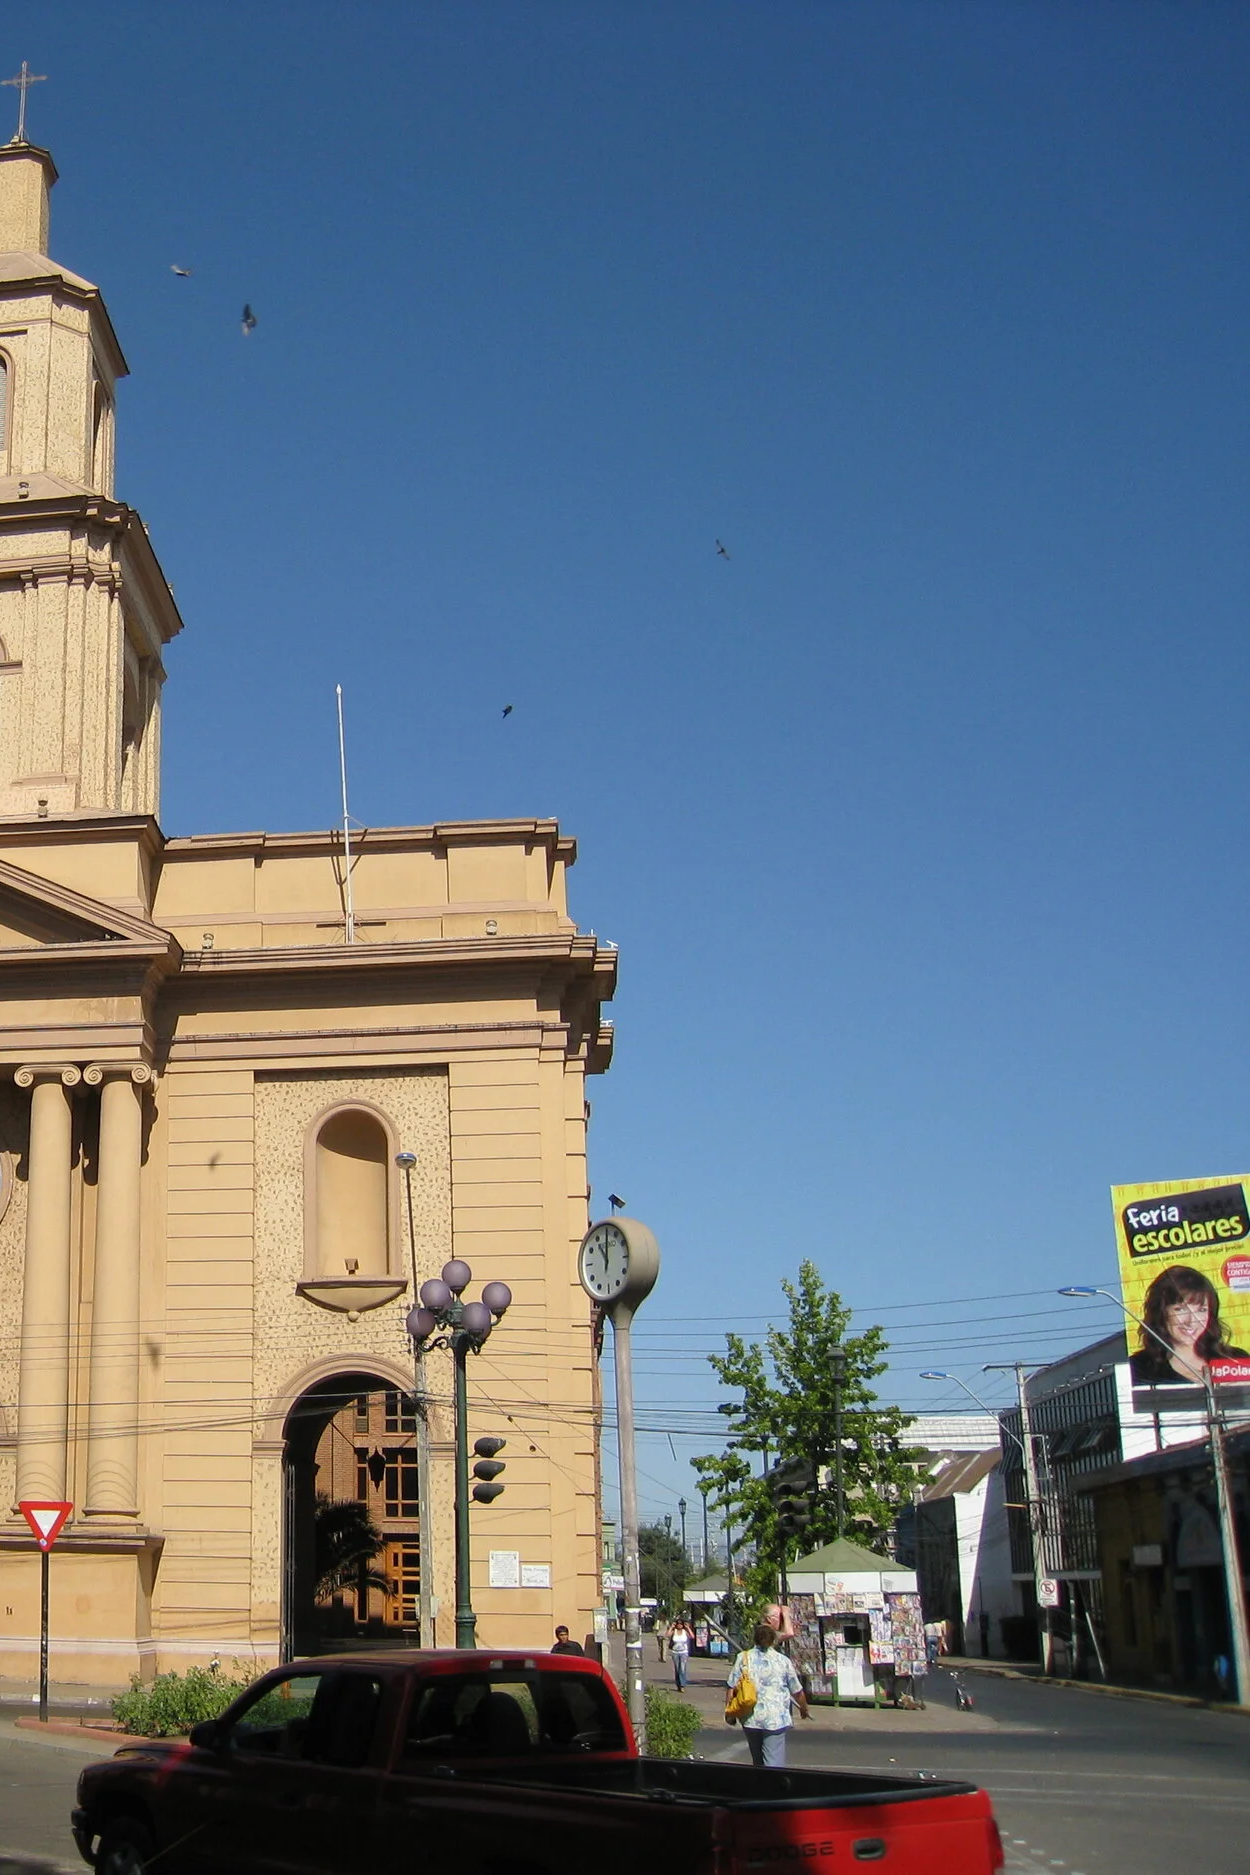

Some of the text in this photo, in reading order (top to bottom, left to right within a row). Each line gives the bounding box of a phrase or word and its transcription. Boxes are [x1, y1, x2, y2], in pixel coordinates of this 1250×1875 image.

[1132, 1215, 1243, 1252] escolares
[1211, 1364, 1250, 1377] laPola
[748, 1841, 834, 1861] DODGE
